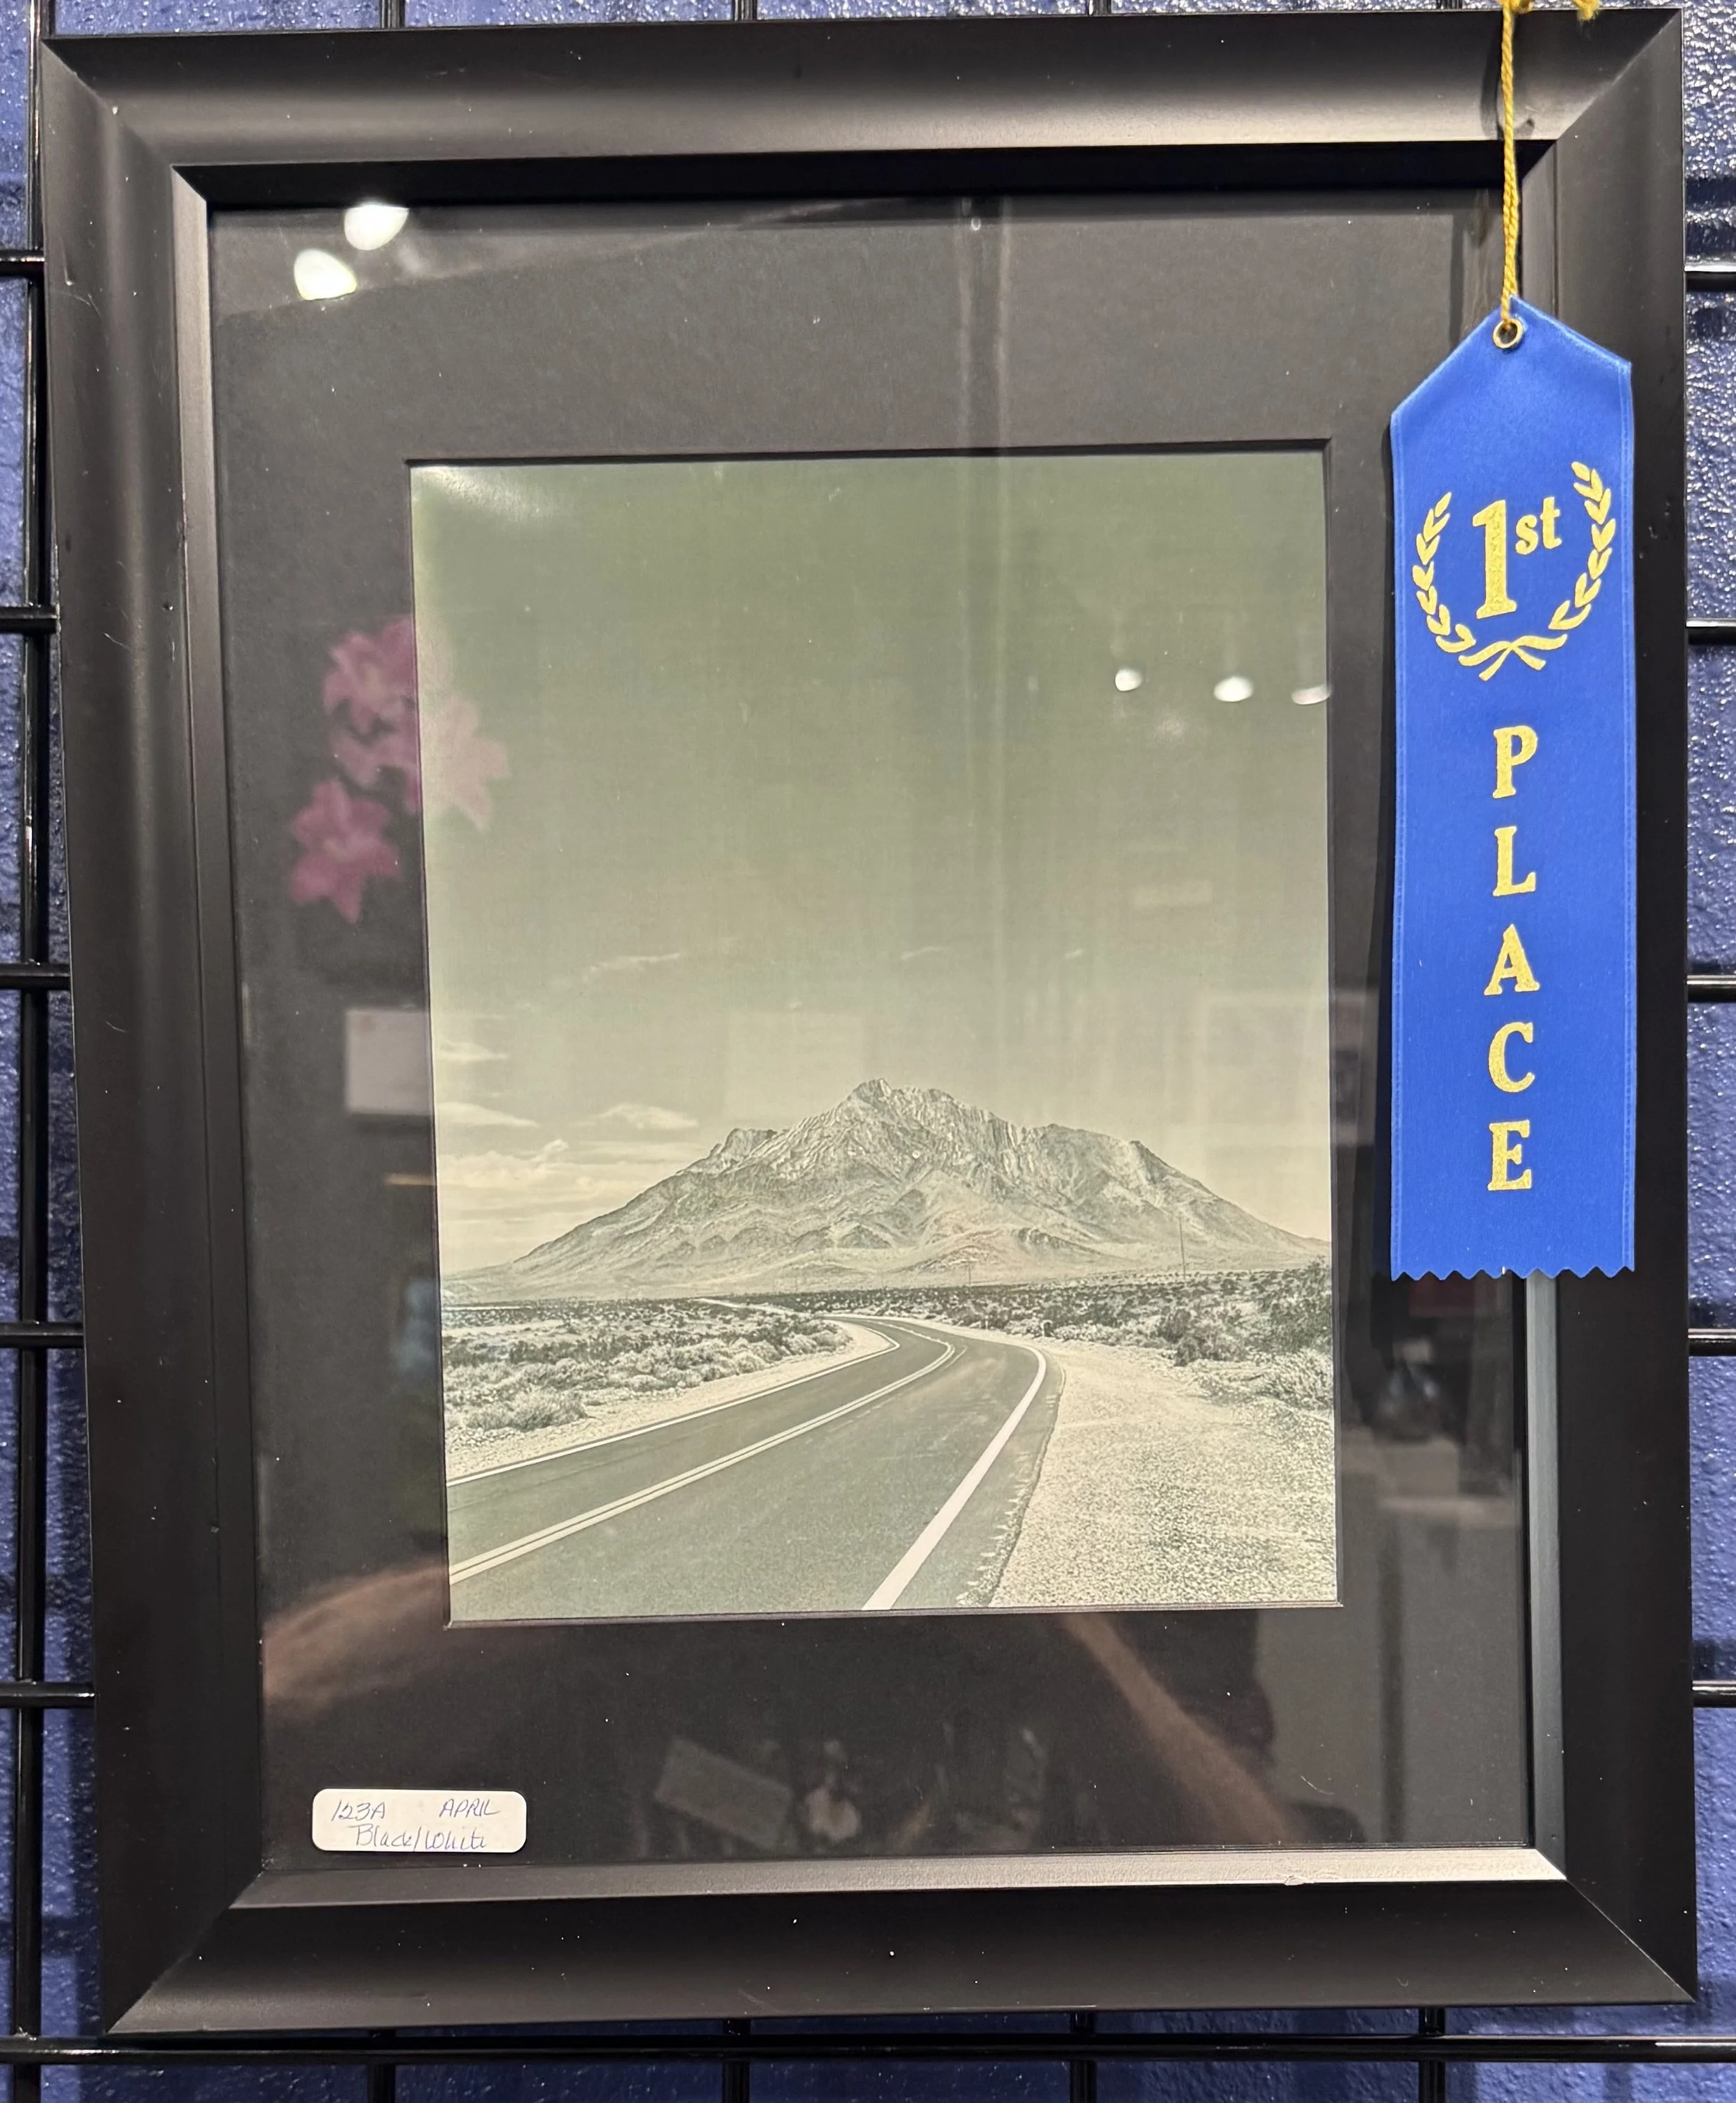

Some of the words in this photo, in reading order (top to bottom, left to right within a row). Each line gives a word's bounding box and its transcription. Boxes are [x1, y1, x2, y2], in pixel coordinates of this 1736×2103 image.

[1472, 496, 1562, 619] 1st
[1484, 725, 1539, 1191] PLACE
[439, 1798, 501, 1818] APRIL
